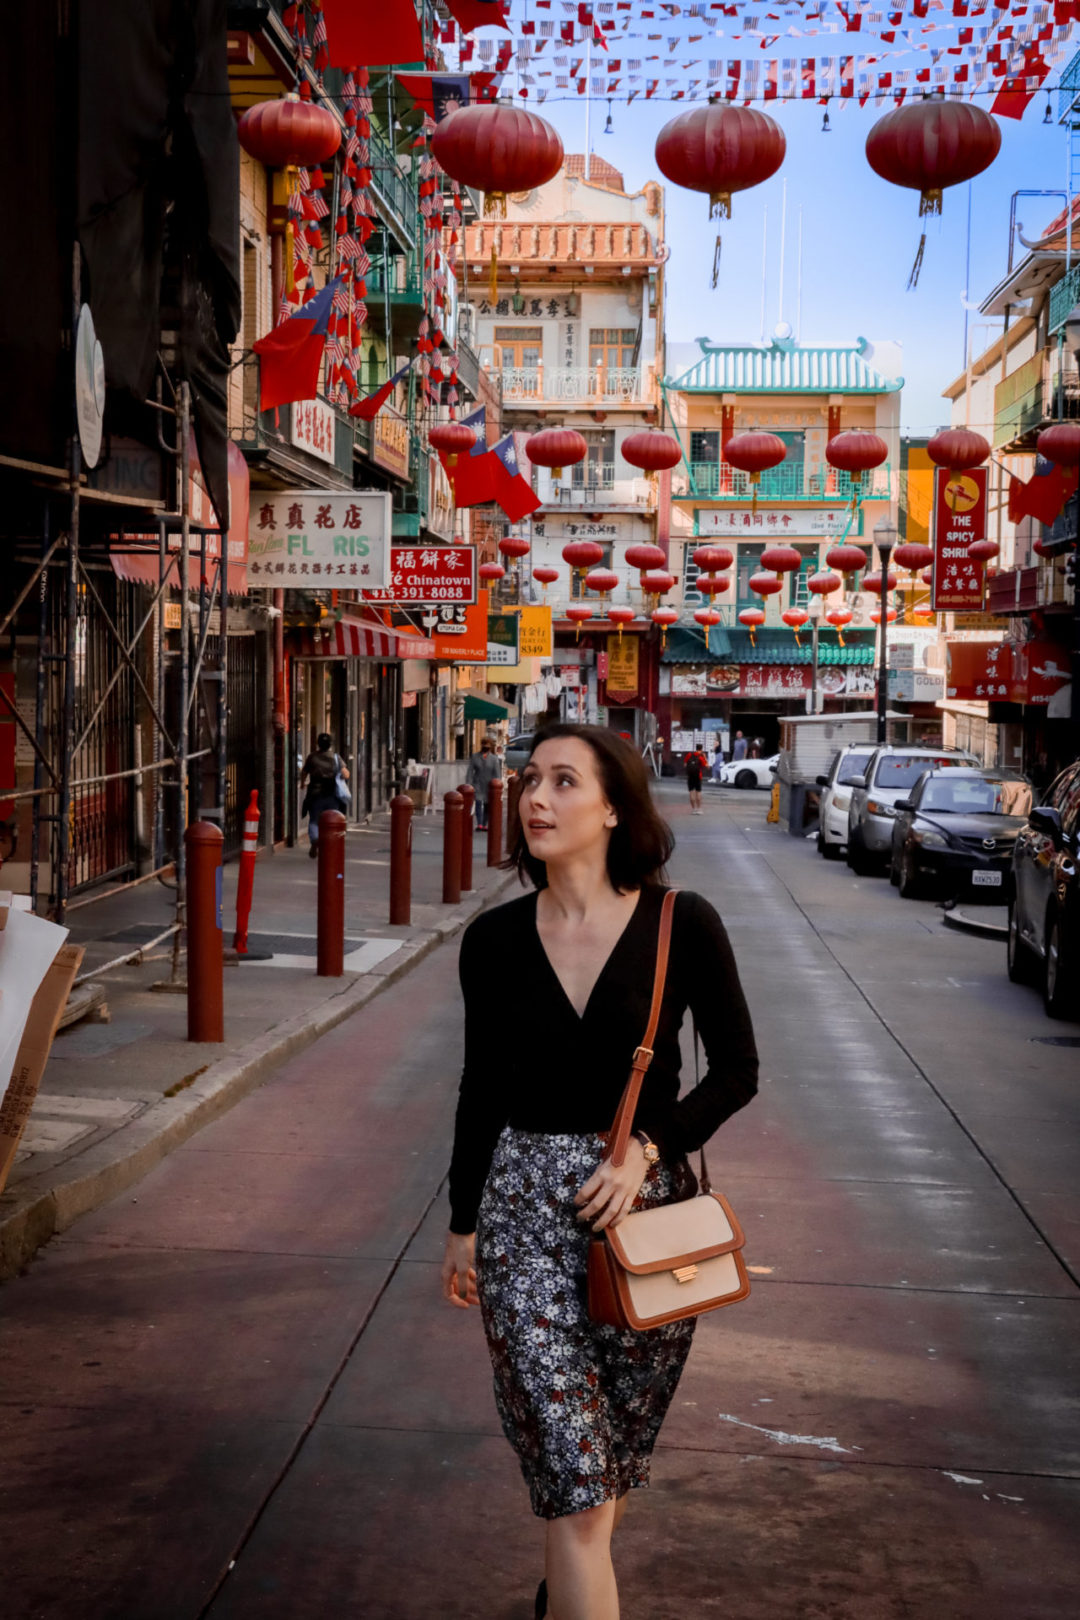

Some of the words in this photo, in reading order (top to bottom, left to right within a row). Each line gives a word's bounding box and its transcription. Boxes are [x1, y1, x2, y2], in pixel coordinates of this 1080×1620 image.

[257, 503, 362, 530] 真真花店
[952, 516, 971, 526] THE
[946, 532, 975, 542] SPICY
[407, 575, 471, 585] Chinatown
[372, 587, 463, 598] 415-391-8088
